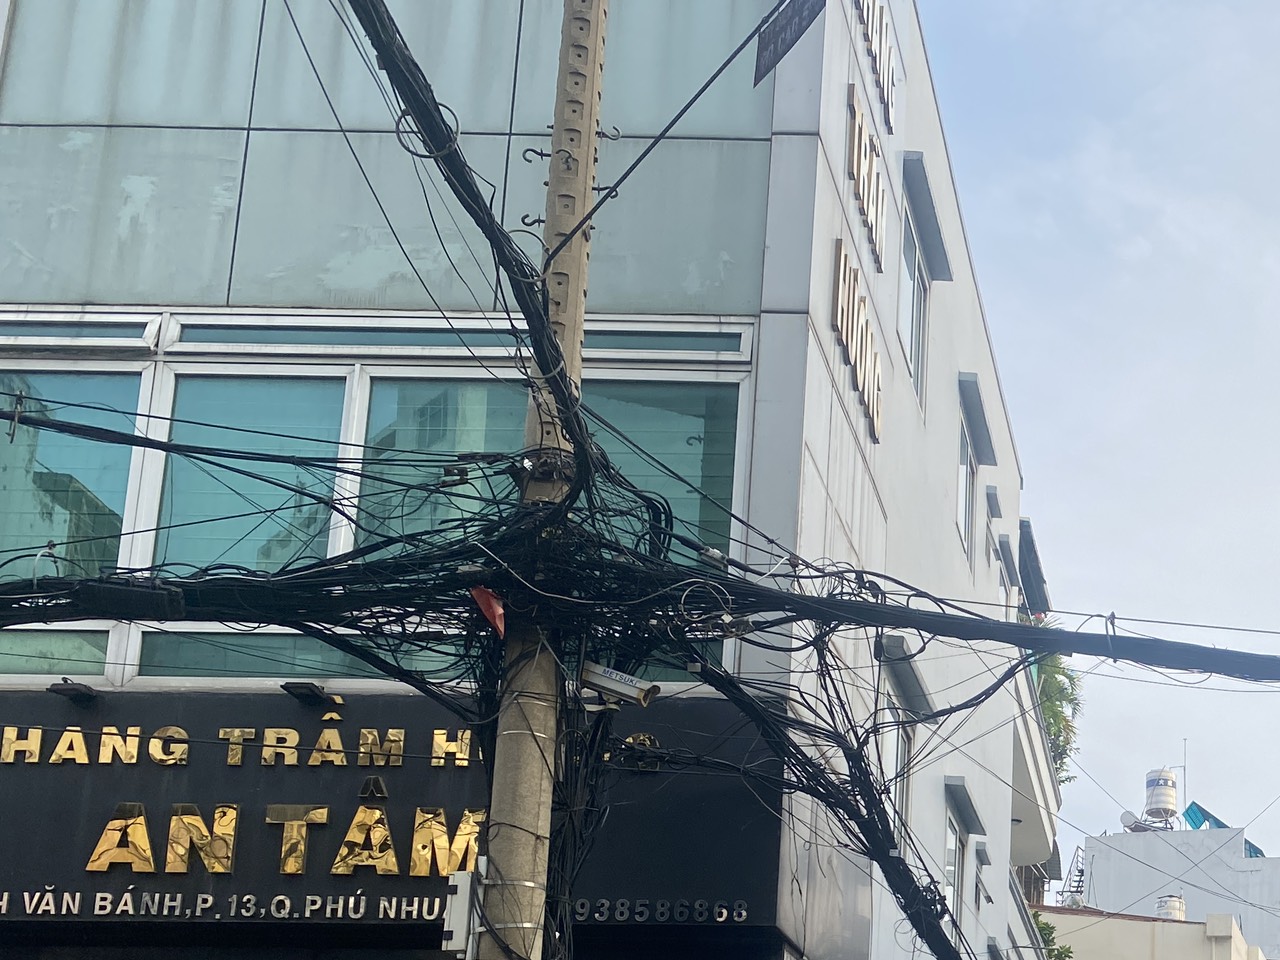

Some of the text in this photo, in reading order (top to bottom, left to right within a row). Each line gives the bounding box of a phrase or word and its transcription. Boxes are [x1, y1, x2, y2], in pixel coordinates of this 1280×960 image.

[602, 668, 638, 686] METSUKI
[218, 694, 405, 767] TRẦM
[85, 775, 487, 878] AN TÂM
[23, 884, 81, 915] VĂN
[378, 896, 448, 921] NHU
